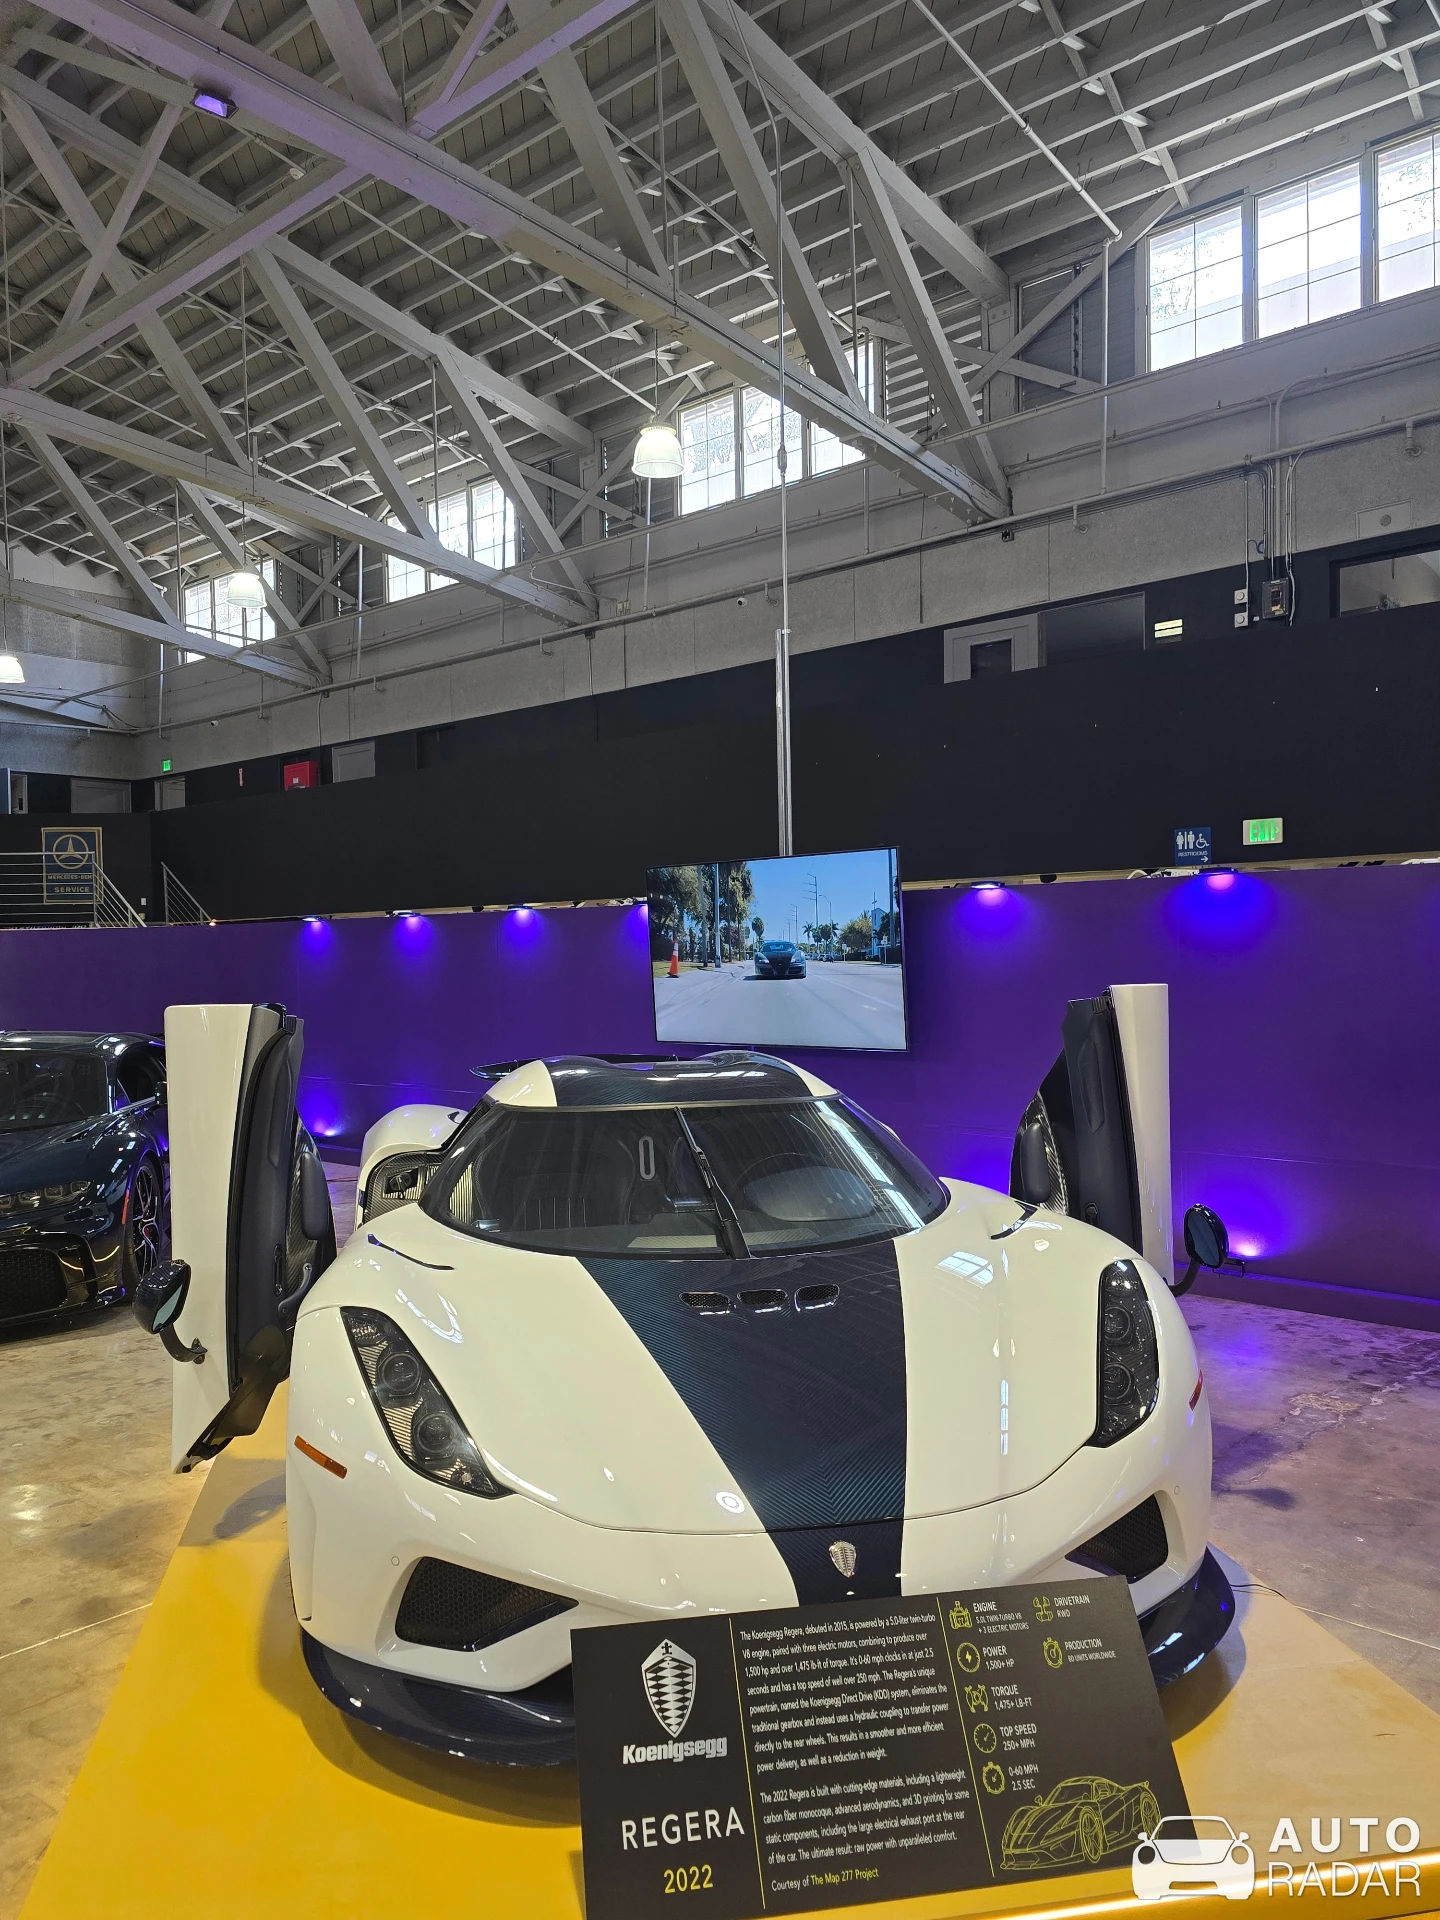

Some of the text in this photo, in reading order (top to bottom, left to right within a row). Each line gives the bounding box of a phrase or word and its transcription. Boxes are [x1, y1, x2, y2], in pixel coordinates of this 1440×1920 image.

[1249, 818, 1276, 842] EXIT
[972, 1601, 997, 1613] ENGINE
[1053, 1594, 1090, 1607] DRIVETRAIN
[985, 1612, 1015, 1622] TWIN-TURBO
[1056, 1608, 1071, 1617] RWD
[739, 1630, 751, 1640] The
[751, 1629, 784, 1641] Koenigsegg
[783, 1626, 805, 1639] Regera,
[804, 1622, 827, 1634] debuted
[827, 1622, 833, 1632] in
[833, 1620, 849, 1631] 2015,
[848, 1620, 854, 1630] is
[854, 1617, 878, 1632] powered
[877, 1617, 885, 1629] by
[889, 1615, 909, 1626] 5.0-liter
[909, 1612, 936, 1623] twin-turbo
[986, 1623, 1009, 1633] ELECTRIC
[1008, 1621, 1029, 1631] MOTORS
[741, 1632, 927, 1660] V8 engine, paired with three electric motors, combining to produce over
[982, 1645, 1007, 1657] POWER
[1064, 1638, 1102, 1650] PRODUCTION
[985, 1658, 1014, 1671] 1,500+ HP
[1074, 1653, 1089, 1662] UNITS
[1087, 1650, 1116, 1660] WORLDWIDE
[749, 1701, 780, 1717] powertrain,
[780, 1698, 799, 1710] named
[799, 1698, 809, 1708] the
[809, 1695, 842, 1708] Koenigsegg
[841, 1693, 859, 1704] Direct
[858, 1691, 873, 1702] Drive
[890, 1688, 911, 1701] system,
[911, 1684, 938, 1696] eliminates
[937, 1682, 947, 1693] the
[990, 1684, 1019, 1697] TORQUE
[994, 1696, 1032, 1711] 1,475+ LB-FT
[751, 1719, 779, 1733] traditional
[780, 1717, 803, 1732] gearbox
[803, 1715, 815, 1727] and
[814, 1713, 835, 1725] instead
[835, 1714, 849, 1723] uses
[853, 1708, 879, 1723] hydraulic
[879, 1706, 903, 1719] coupling
[902, 1707, 910, 1715] to
[910, 1702, 931, 1714] transfer
[931, 1702, 949, 1715] power
[754, 1739, 774, 1753] directly
[775, 1740, 782, 1750] to
[782, 1738, 792, 1749] the
[793, 1738, 804, 1748] rear
[805, 1734, 826, 1746] wheels.
[826, 1732, 839, 1743] This
[839, 1730, 858, 1742] results
[857, 1729, 864, 1740] in
[869, 1726, 895, 1739] smoother
[896, 1723, 907, 1736] and
[907, 1725, 922, 1734] more
[922, 1721, 945, 1733] efficient
[999, 1723, 1037, 1737] TOP SPEED
[622, 1736, 728, 1765] Koenigsegg
[1002, 1737, 1035, 1751] 250+ MPH
[756, 1762, 774, 1775] power
[775, 1758, 799, 1770] delivery,
[799, 1758, 807, 1767] as
[807, 1754, 820, 1766] well
[820, 1755, 827, 1765] as
[832, 1750, 860, 1763] reduction
[859, 1749, 866, 1759] in
[865, 1746, 887, 1761] weight.
[1008, 1763, 1039, 1777] 0-60 MPH
[759, 1792, 772, 1803] The
[772, 1789, 788, 1802] 2022
[788, 1788, 810, 1802] Regera
[809, 1786, 816, 1797] is
[815, 1785, 830, 1797] built
[829, 1783, 842, 1794] with
[842, 1779, 878, 1794] cutting-edge
[878, 1775, 905, 1788] materials,
[904, 1773, 931, 1786] including
[934, 1768, 966, 1784] lightweight
[1011, 1778, 1036, 1791] 2.5 SEC
[763, 1789, 970, 1824] carbon fiber monocoque, advanced aerodynamics, and 3D printing for some
[621, 1806, 745, 1851] REGERA
[765, 1810, 965, 1844] static components, including the large electrical exhaust port at the rear
[768, 1829, 958, 1864] of the car. The ultimate result: raw power with unparalleled comfort.
[663, 1864, 714, 1894] 2022
[771, 1867, 879, 1891] Courtesy of The Map 277 Project
